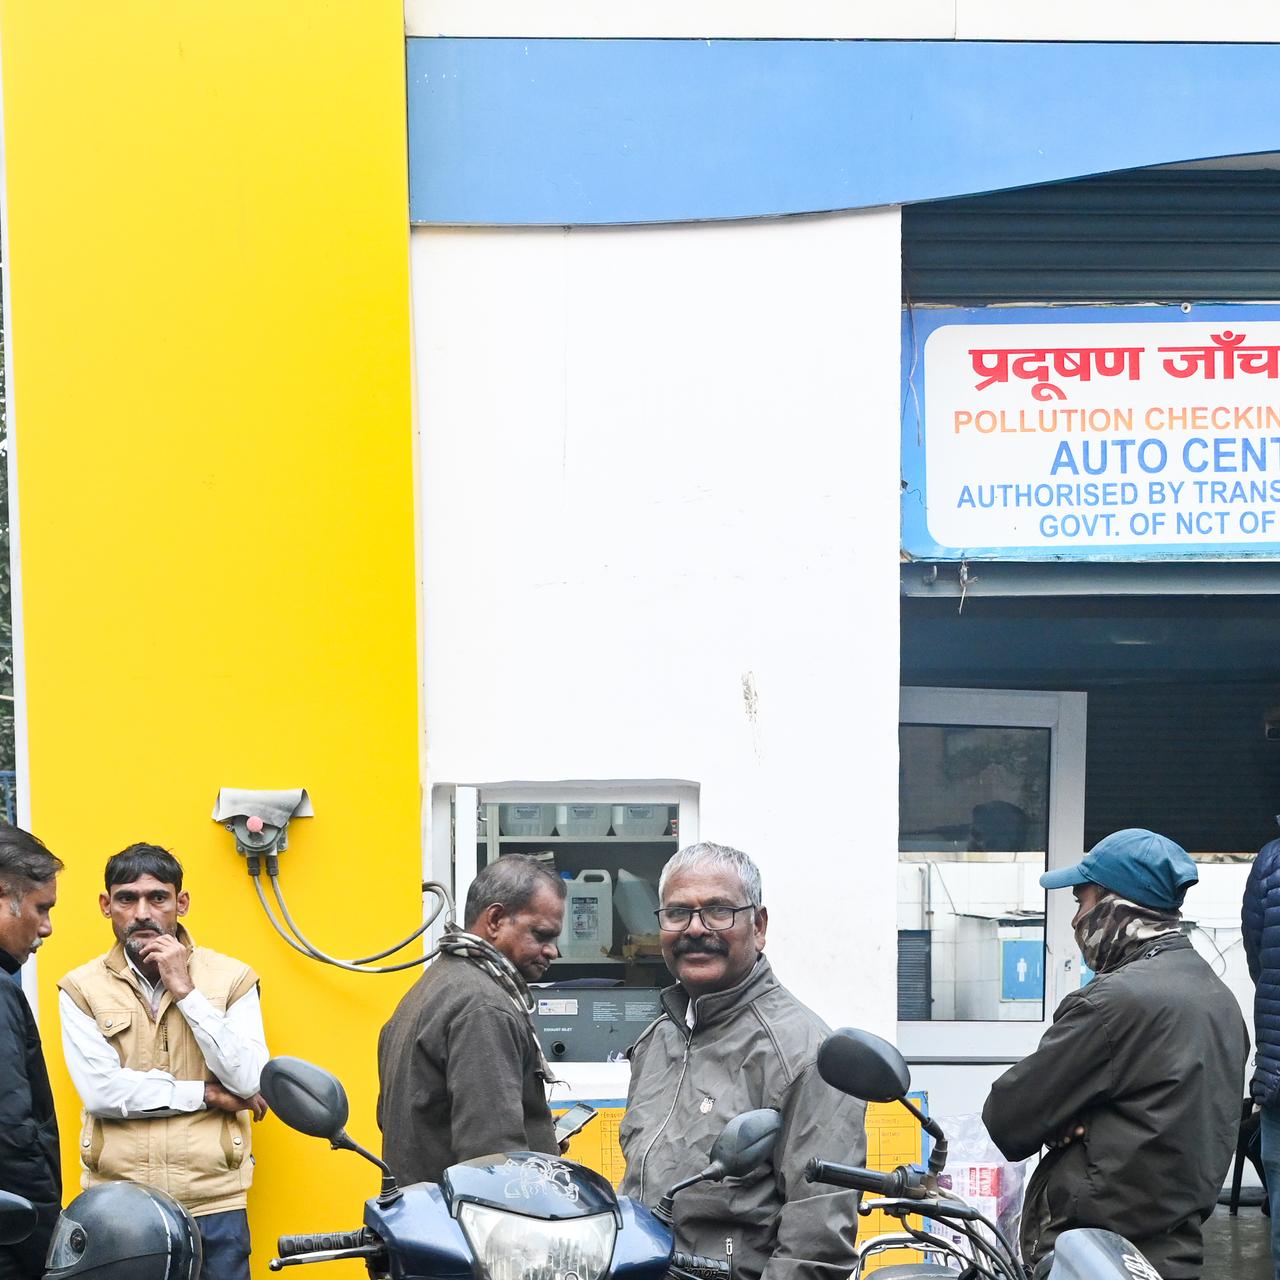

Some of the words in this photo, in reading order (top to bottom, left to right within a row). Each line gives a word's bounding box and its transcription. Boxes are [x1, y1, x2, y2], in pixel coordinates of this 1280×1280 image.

[968, 346, 1145, 402] प्रदूषण
[954, 408, 1134, 434] POLLUTION
[1050, 438, 1167, 476] AUTO
[956, 481, 1139, 509] AUTHORISED
[1148, 480, 1186, 505] BY
[1038, 512, 1121, 539] GOVT.
[1130, 511, 1166, 536] OF
[1176, 510, 1230, 535] NCT
[1238, 509, 1277, 534] OF
